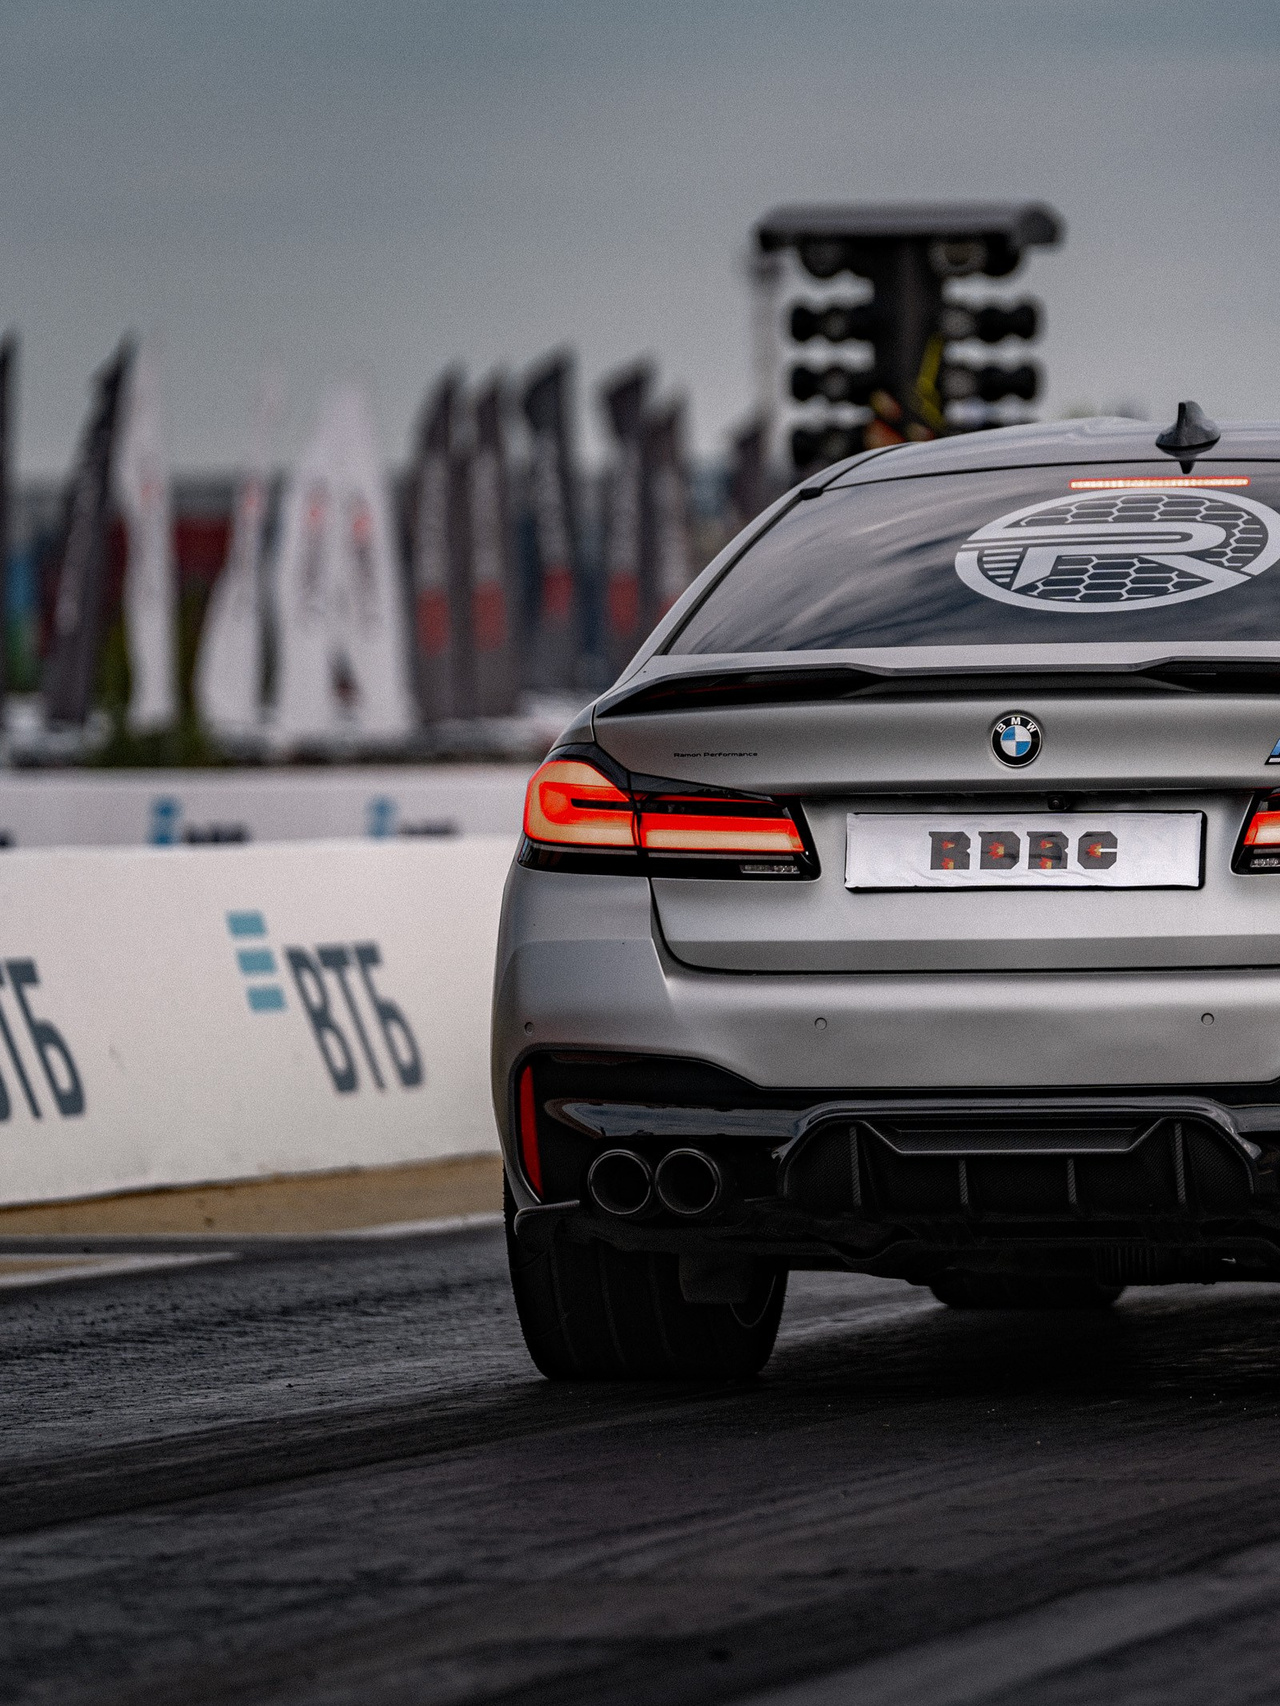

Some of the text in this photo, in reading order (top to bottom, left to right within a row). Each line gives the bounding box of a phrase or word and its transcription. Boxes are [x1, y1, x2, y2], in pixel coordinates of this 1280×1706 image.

[995, 717, 1037, 733] BMW
[0, 957, 86, 1122] ТБ
[284, 941, 424, 1094] ВТБ
